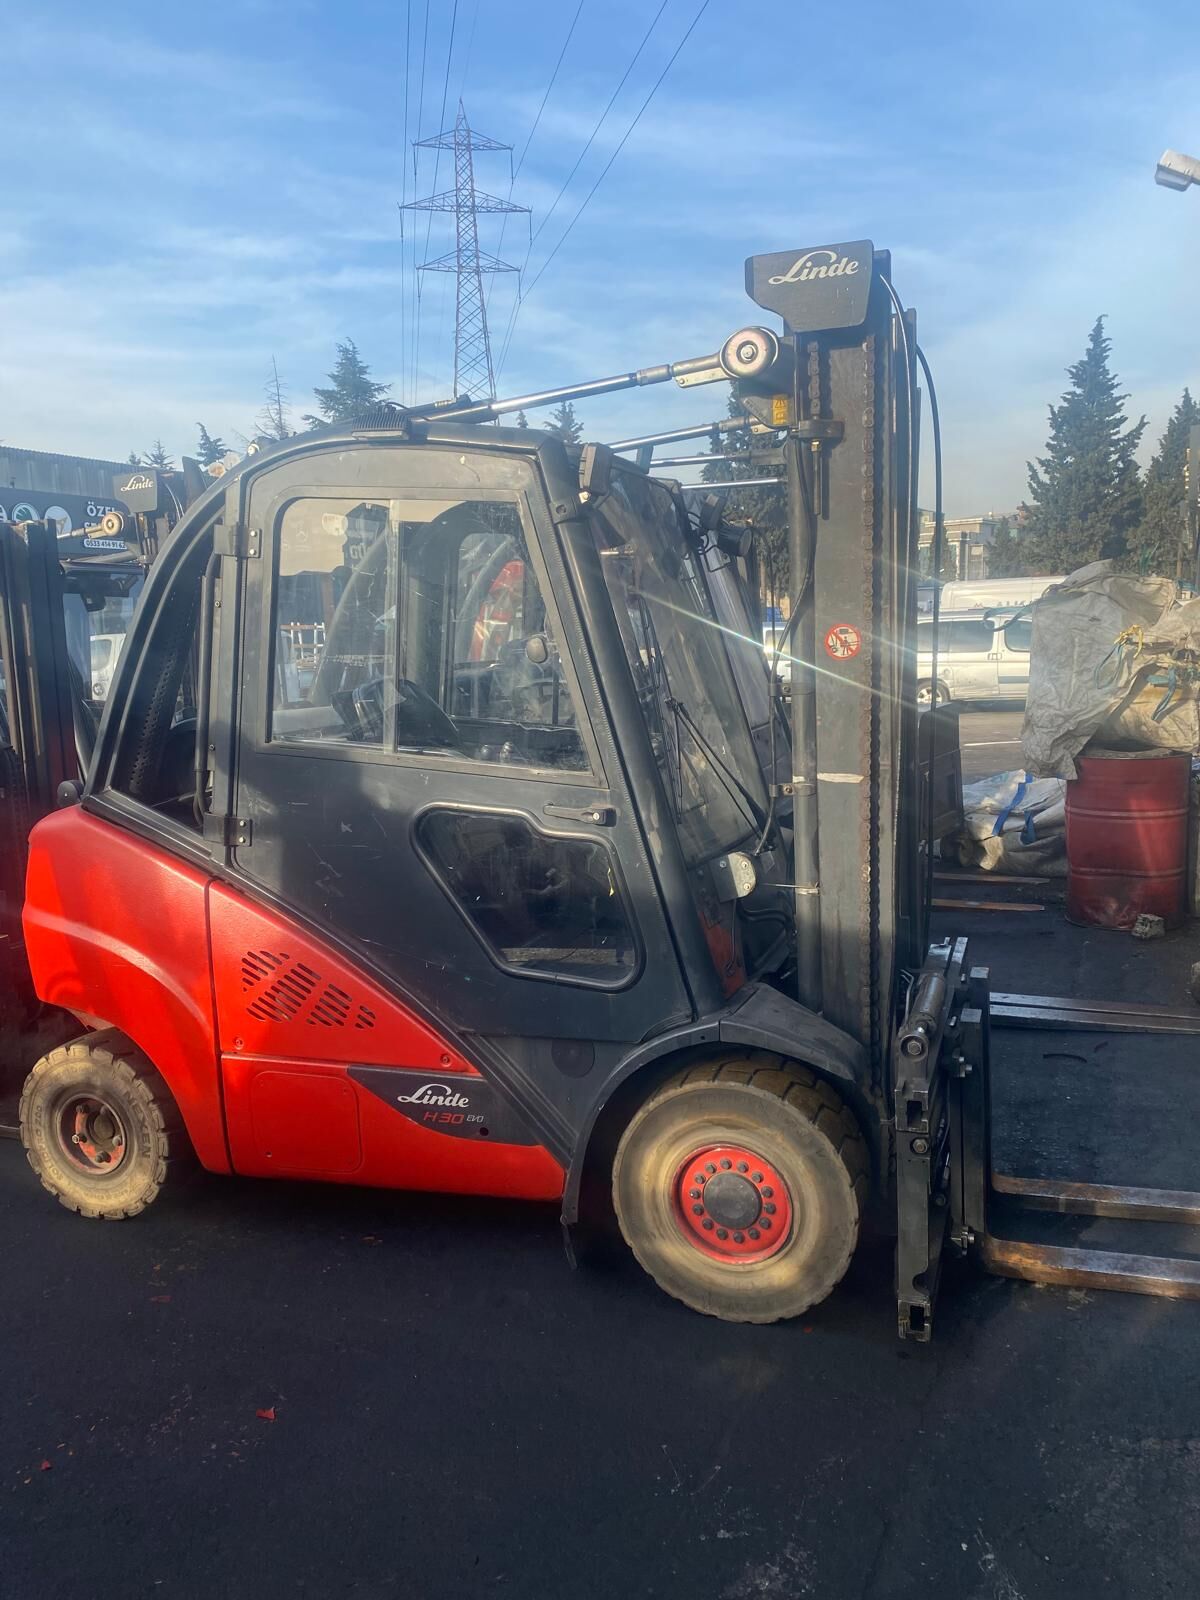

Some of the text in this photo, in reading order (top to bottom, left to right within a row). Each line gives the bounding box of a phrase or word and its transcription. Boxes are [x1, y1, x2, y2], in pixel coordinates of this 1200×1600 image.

[768, 250, 859, 285] Linde
[120, 475, 153, 491] Linde
[397, 1083, 470, 1108] Linde
[466, 1114, 484, 1123] EVO
